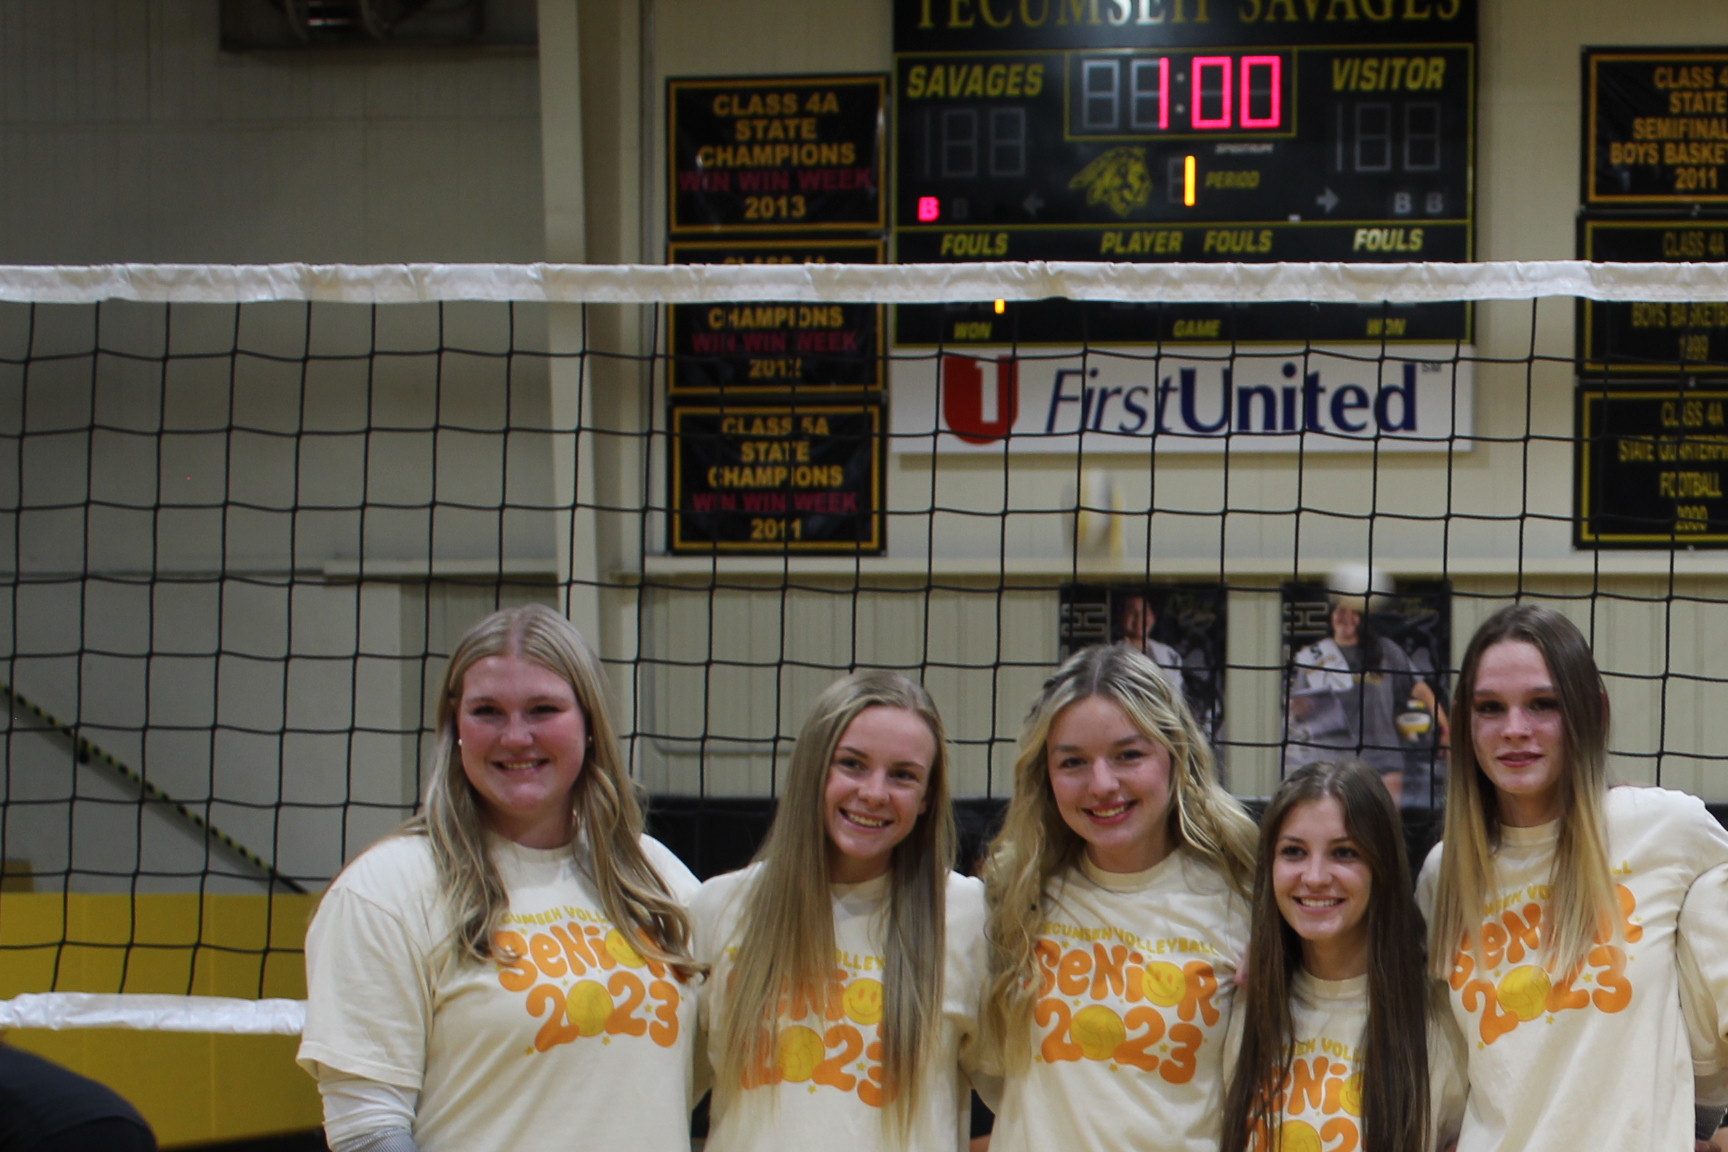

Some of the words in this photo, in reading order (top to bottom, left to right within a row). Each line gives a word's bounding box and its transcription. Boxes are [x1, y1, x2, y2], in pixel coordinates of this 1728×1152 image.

[907, 64, 1044, 97] SAVAGES
[1332, 57, 1445, 91] VISITOR
[1653, 66, 1714, 88] CLASS
[712, 93, 797, 116] CLASS
[805, 92, 839, 113] 4A
[1669, 91, 1728, 113] STATE
[736, 118, 817, 139] STATE
[699, 142, 856, 167] CHAMPIONS
[1609, 142, 1660, 165] BOYS
[679, 170, 730, 191] WIN
[739, 169, 790, 191] WIN
[797, 167, 875, 191] WEEK
[1205, 170, 1261, 189] PERIOD
[1675, 167, 1718, 189] 2011
[744, 195, 806, 219] 2013
[918, 196, 940, 222] B
[941, 232, 1009, 256] FOULS
[1101, 231, 1184, 254] PLAYER
[1203, 230, 1274, 253] FOULS
[1354, 228, 1424, 251] FOULS
[1662, 231, 1705, 257] CLASS
[707, 305, 844, 329] CHAMPIONS
[1172, 319, 1222, 338] GAME
[954, 321, 992, 340] WON
[1046, 361, 1417, 434] FirstUnited
[722, 416, 791, 438] CLASS
[741, 440, 811, 463] STATE
[1618, 435, 1655, 462] STATE
[707, 465, 844, 488] CHAMPIONS
[692, 493, 737, 513] WN
[794, 491, 859, 512] WEEK
[526, 971, 679, 1053] 2023
[1034, 997, 1204, 1085] 2023
